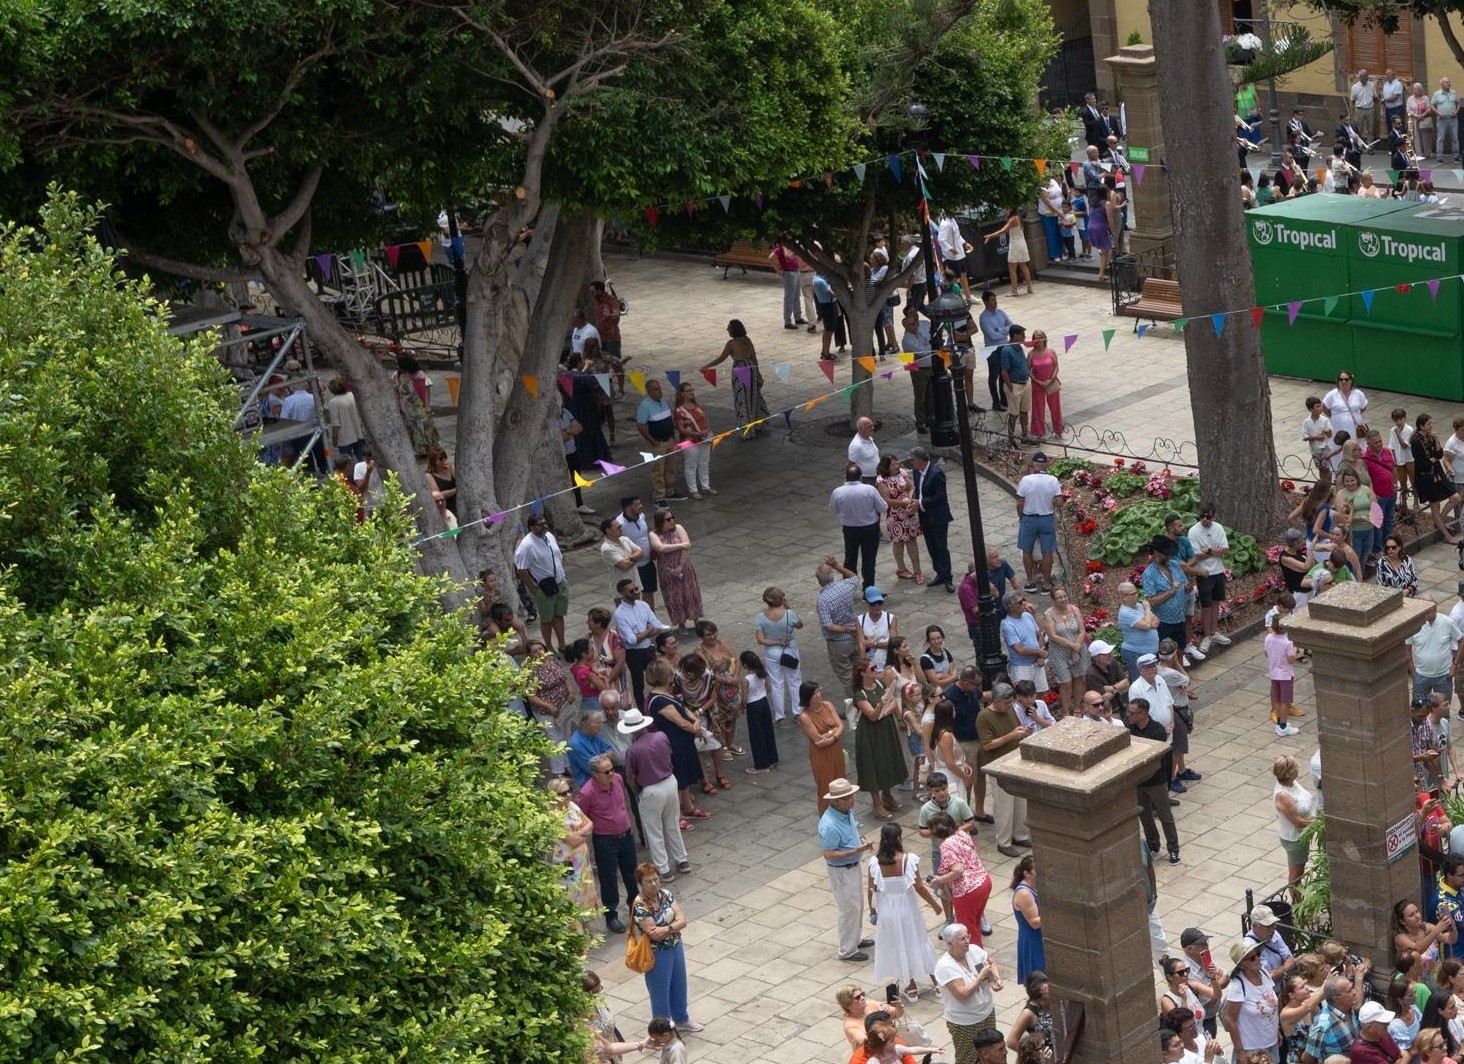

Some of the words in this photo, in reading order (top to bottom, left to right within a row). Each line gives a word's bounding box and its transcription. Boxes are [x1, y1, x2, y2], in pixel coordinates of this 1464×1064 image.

[1130, 150, 1147, 159] SALIDA
[1275, 223, 1337, 250] Tropical
[1381, 236, 1446, 263] Tropical
